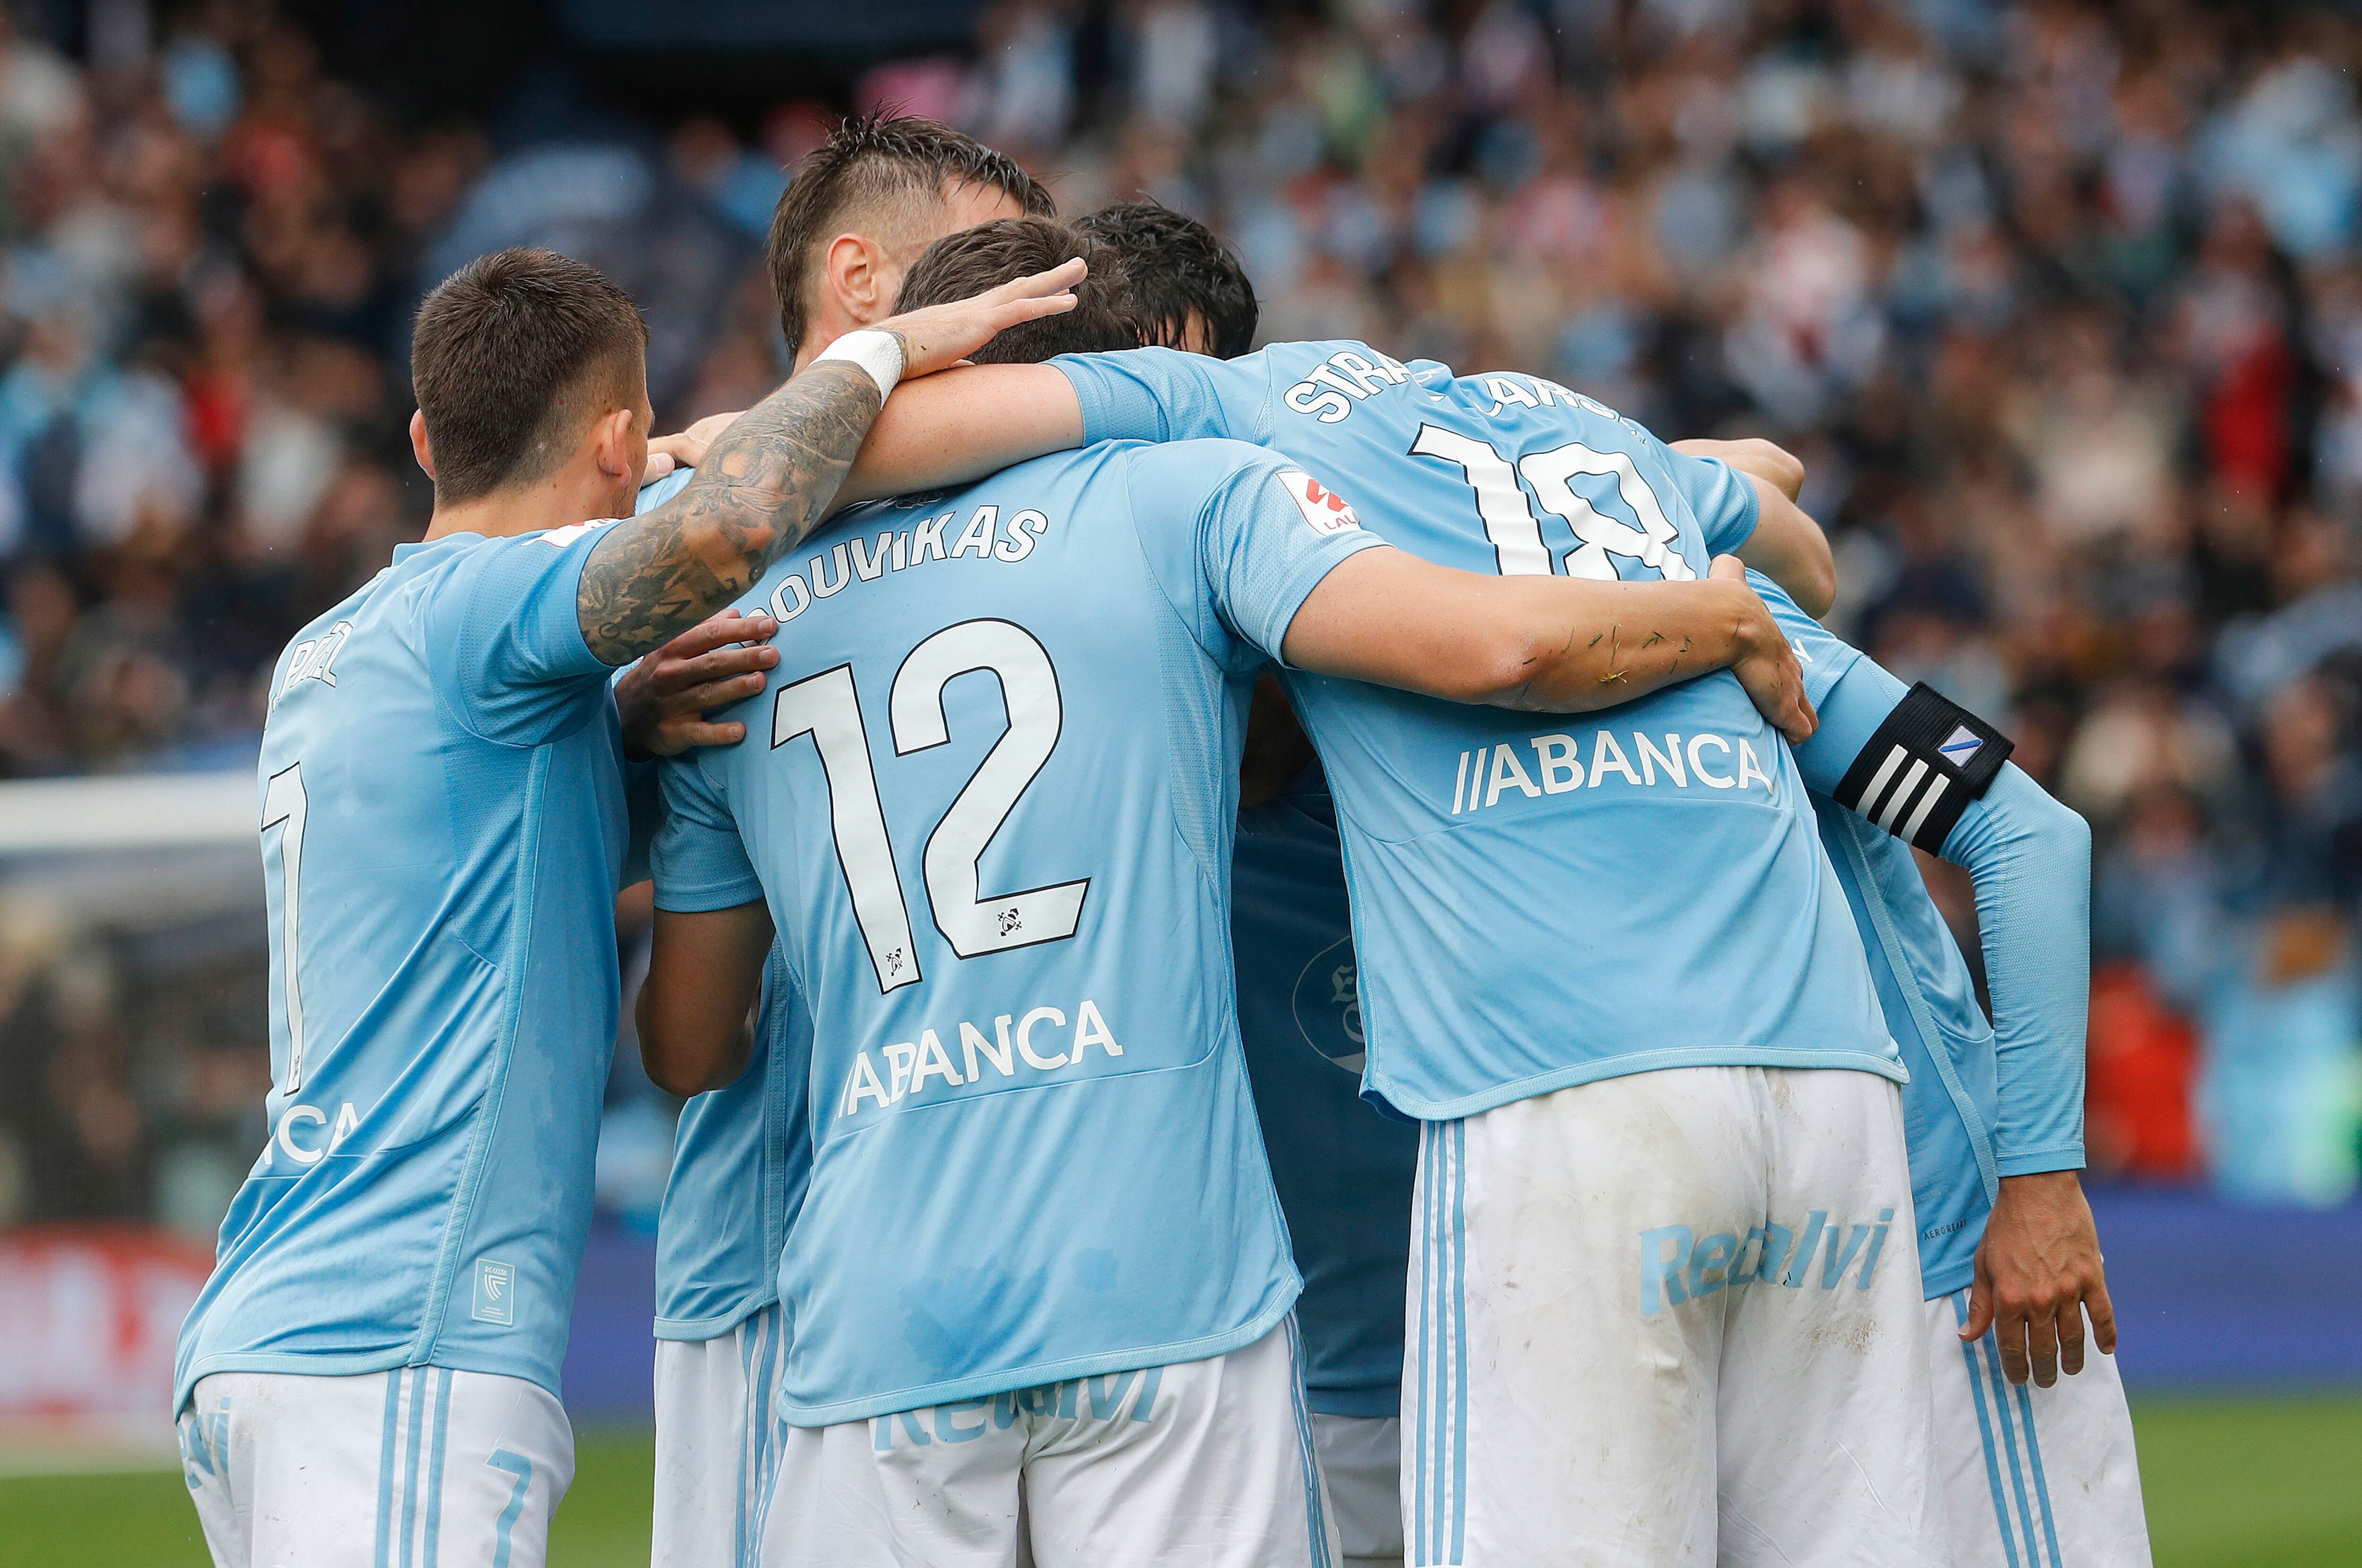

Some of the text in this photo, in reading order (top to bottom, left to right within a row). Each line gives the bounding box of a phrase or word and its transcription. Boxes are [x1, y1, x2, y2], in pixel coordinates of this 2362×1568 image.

[1283, 347, 1446, 424] STRA
[1407, 423, 1697, 581] 18
[738, 505, 1049, 648] OUVIKAS
[771, 617, 1092, 994] 12
[484, 1447, 532, 1568] 7
